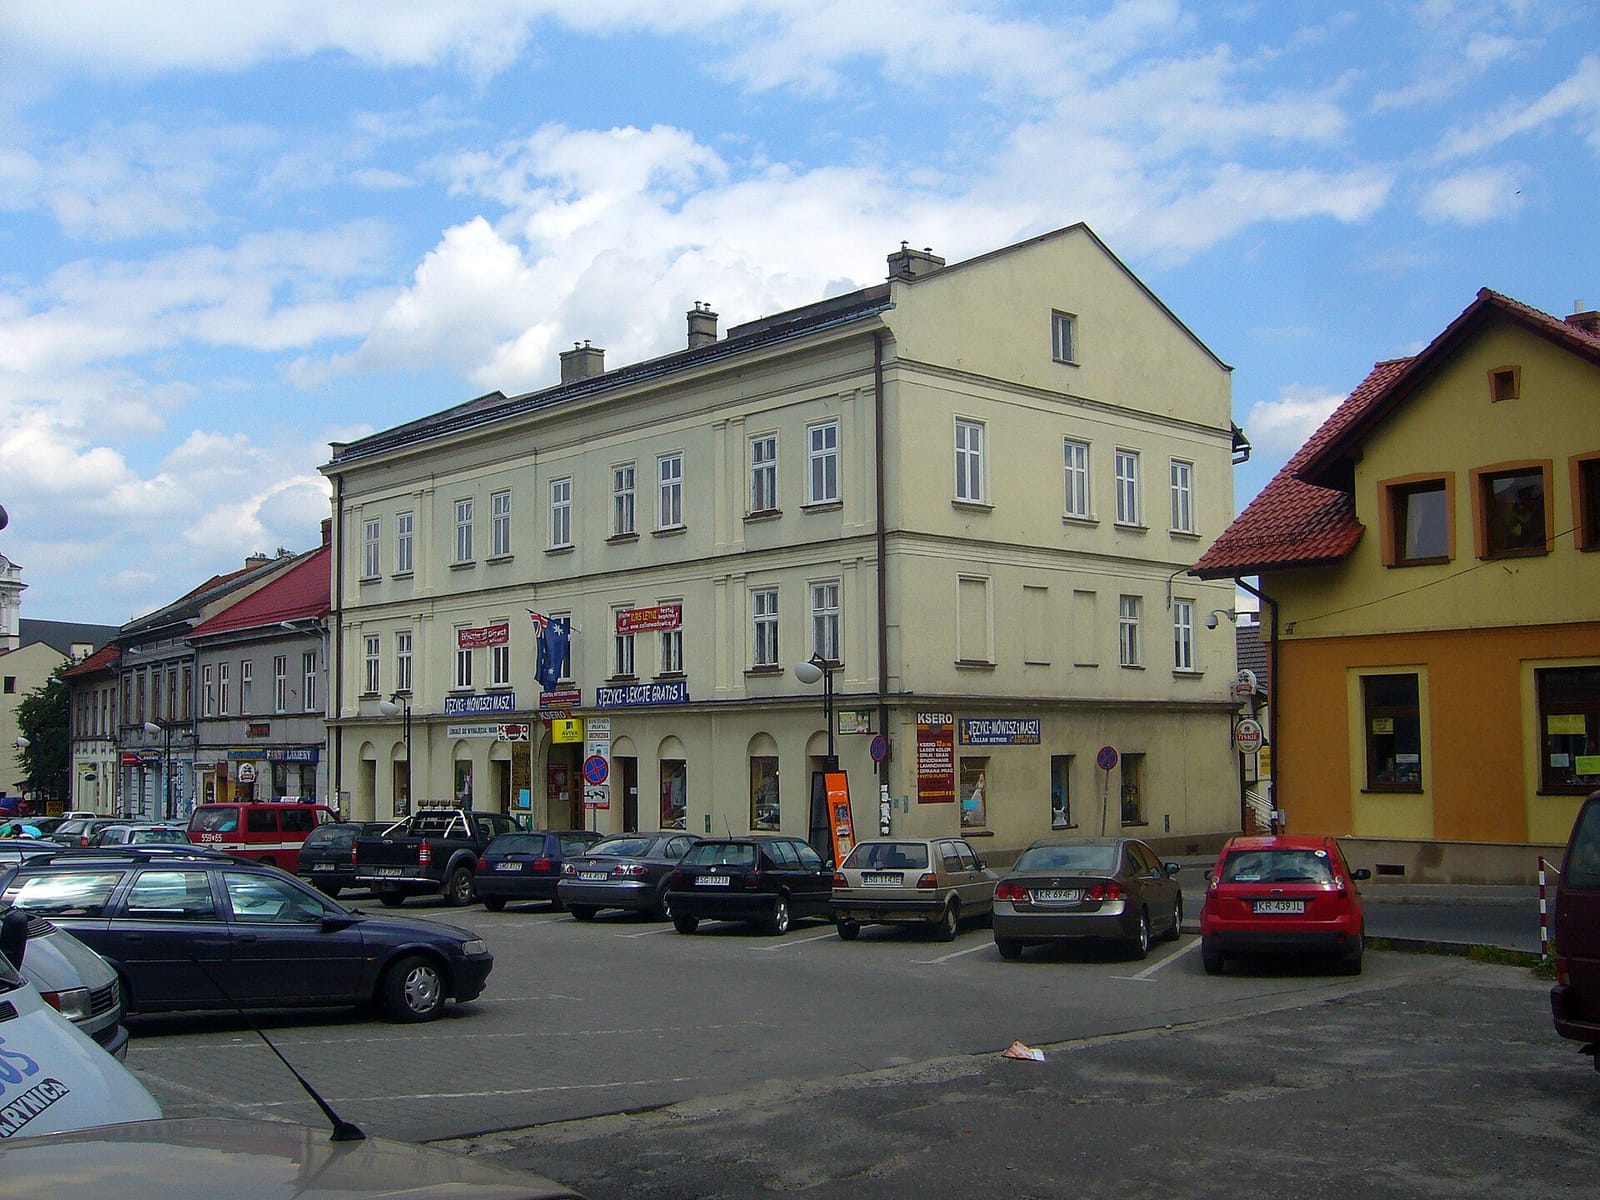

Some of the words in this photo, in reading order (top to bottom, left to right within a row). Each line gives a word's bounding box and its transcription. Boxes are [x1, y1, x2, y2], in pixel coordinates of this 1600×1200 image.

[652, 685, 678, 702] GRATIS
[539, 711, 567, 720] KSERO
[917, 713, 953, 724] KSERO
[1039, 890, 1051, 898] KR
[1259, 901, 1272, 911] KR
[1274, 901, 1303, 911] 439JL
